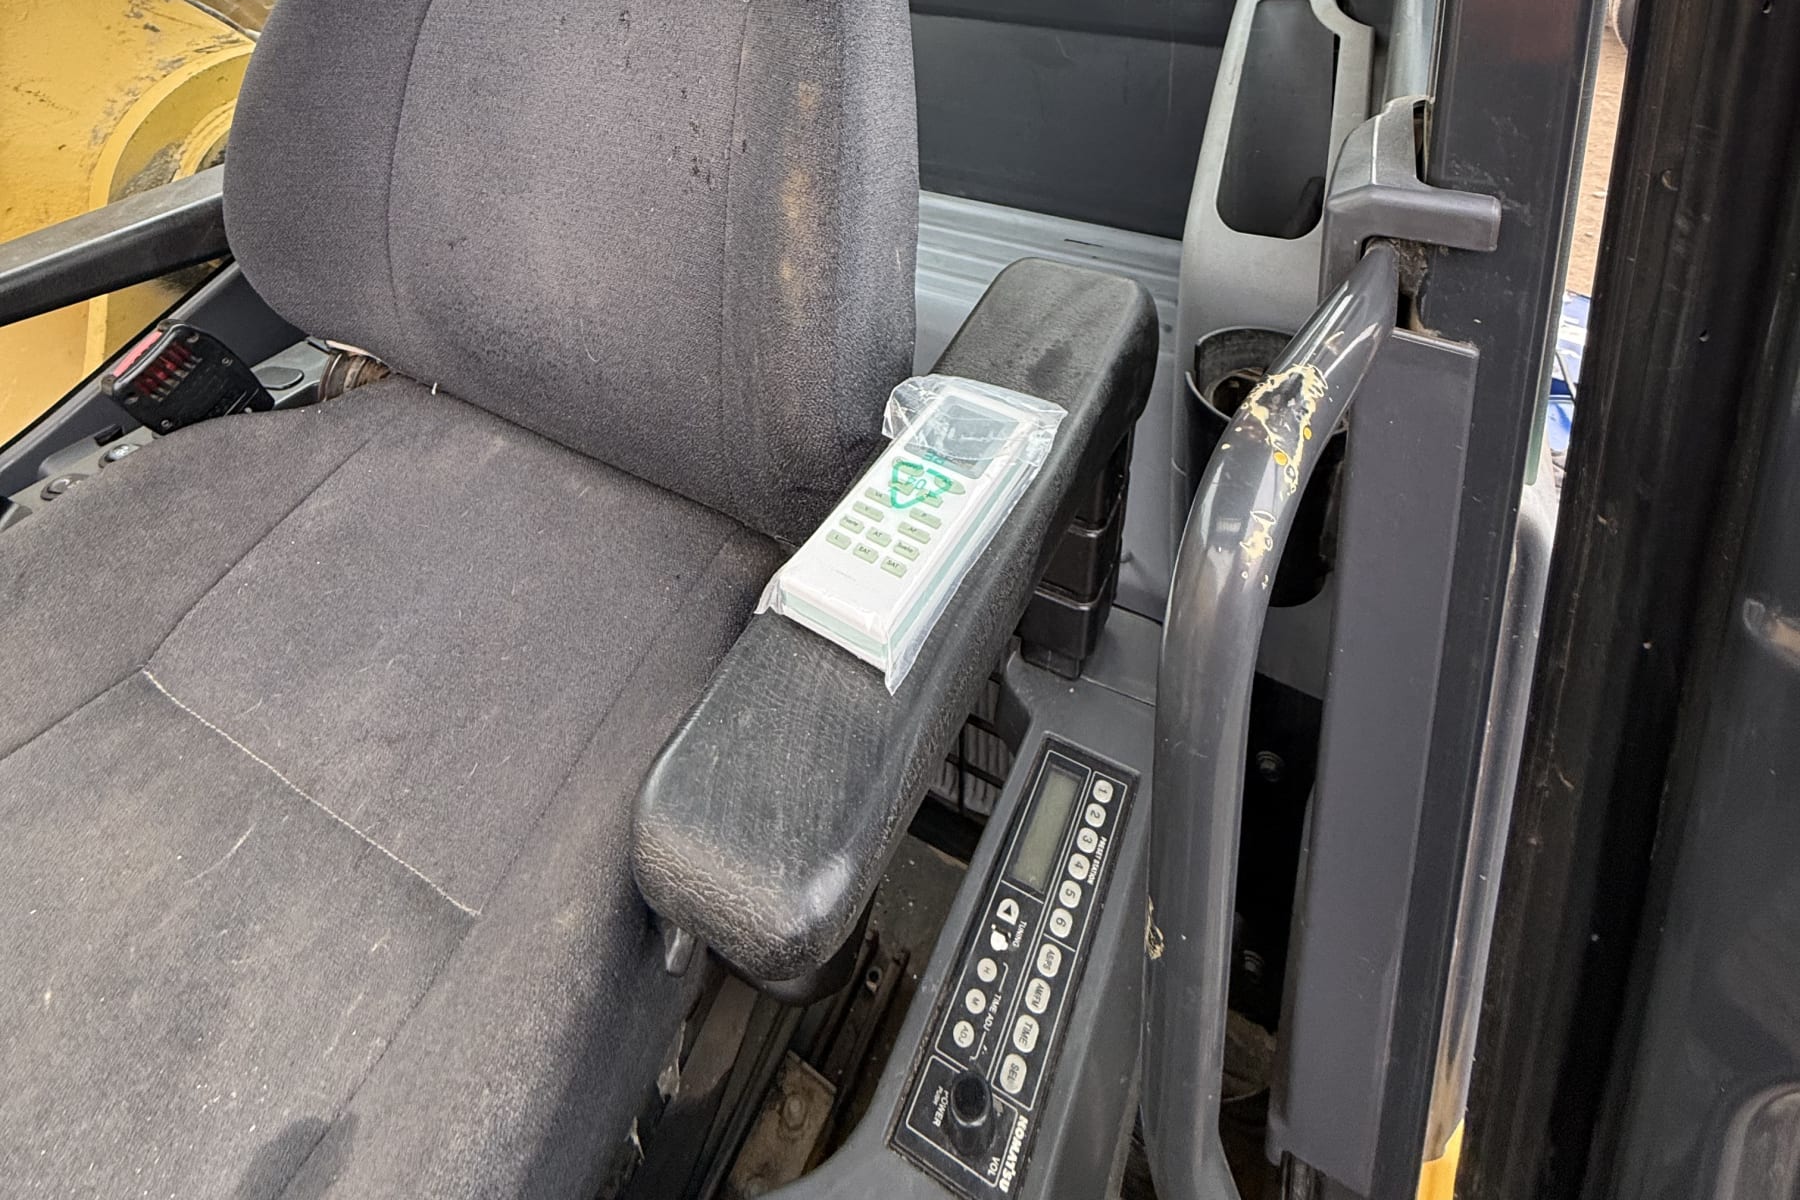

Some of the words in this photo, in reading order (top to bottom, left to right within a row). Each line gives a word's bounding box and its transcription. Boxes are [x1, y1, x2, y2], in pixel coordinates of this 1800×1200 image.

[1098, 786, 1108, 795] 1
[1090, 809, 1101, 820] 2
[1082, 834, 1093, 845] 3
[1095, 835, 1108, 860] PRESET
[1074, 860, 1084, 871] 4
[1086, 859, 1101, 886] STATION
[1065, 888, 1077, 899] 5
[1056, 917, 1067, 929] 6
[1013, 920, 1028, 948] TUNING
[988, 992, 1002, 1016] TIME
[983, 1014, 996, 1032] ADJ
[958, 1025, 970, 1045] ADJ
[1018, 1020, 1034, 1047] TIME
[1006, 1062, 1020, 1082] SEL
[998, 1114, 1029, 1194] KOMATSU
[987, 1155, 1001, 1177] VOL
